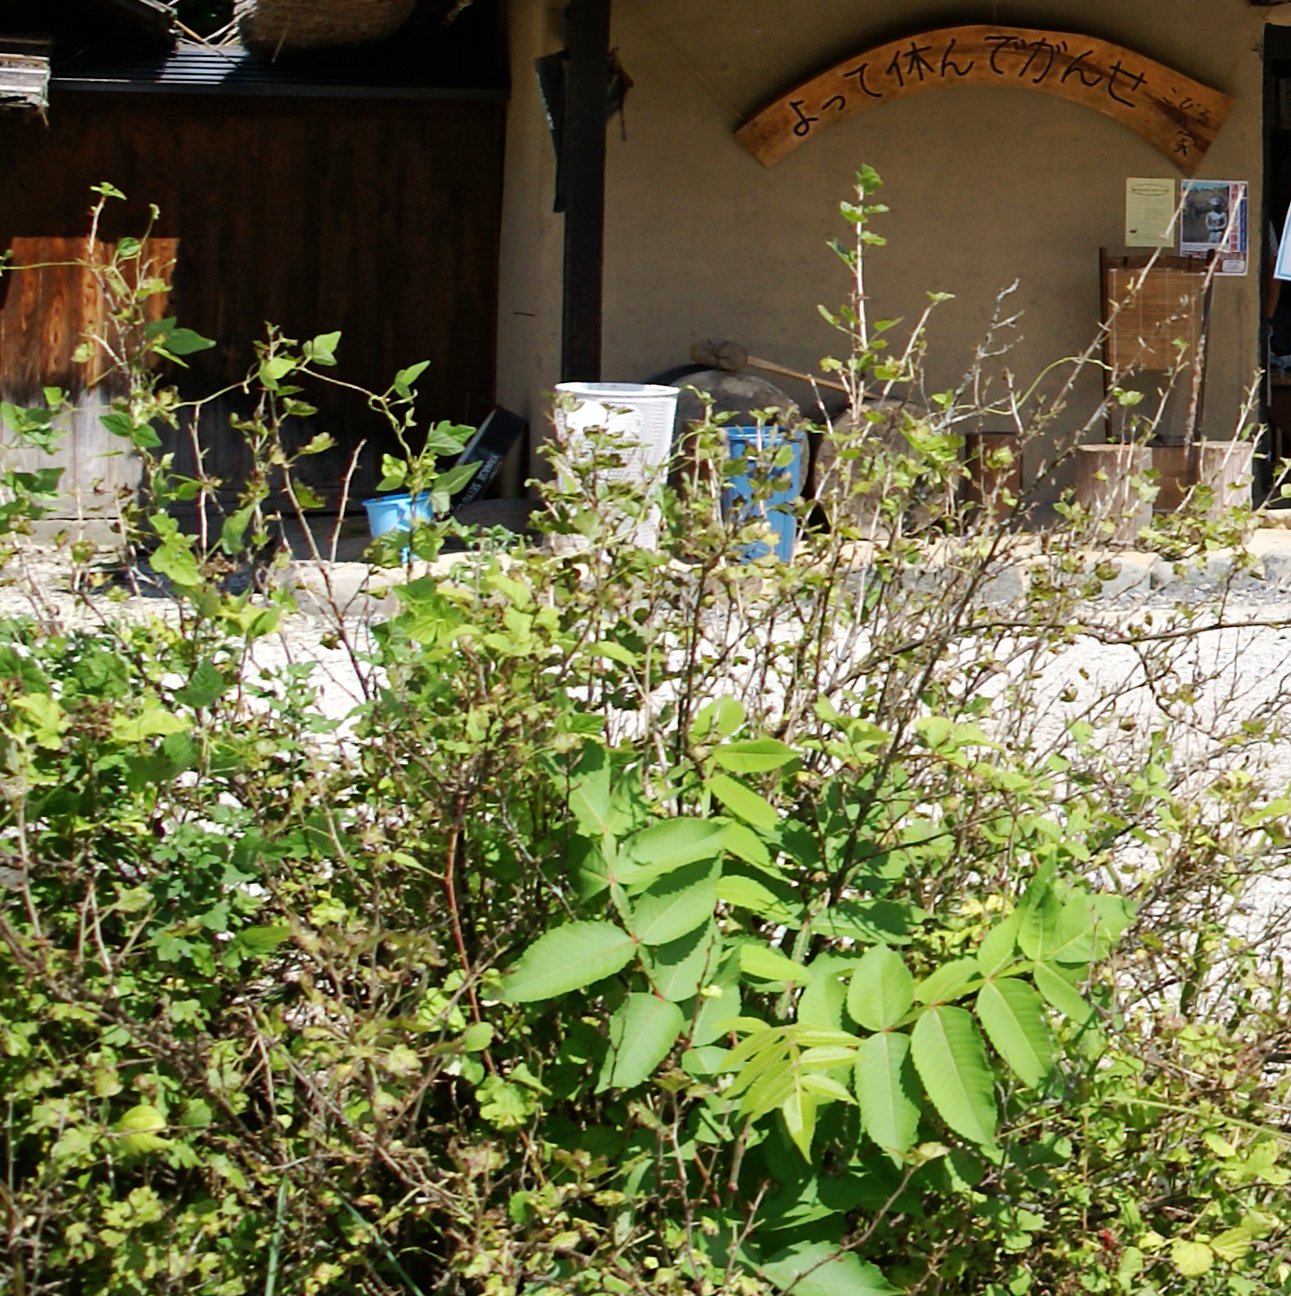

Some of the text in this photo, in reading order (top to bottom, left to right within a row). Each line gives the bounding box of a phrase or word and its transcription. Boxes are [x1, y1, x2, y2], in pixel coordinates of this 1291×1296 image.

[790, 35, 1149, 137] よって休んでがんせ
